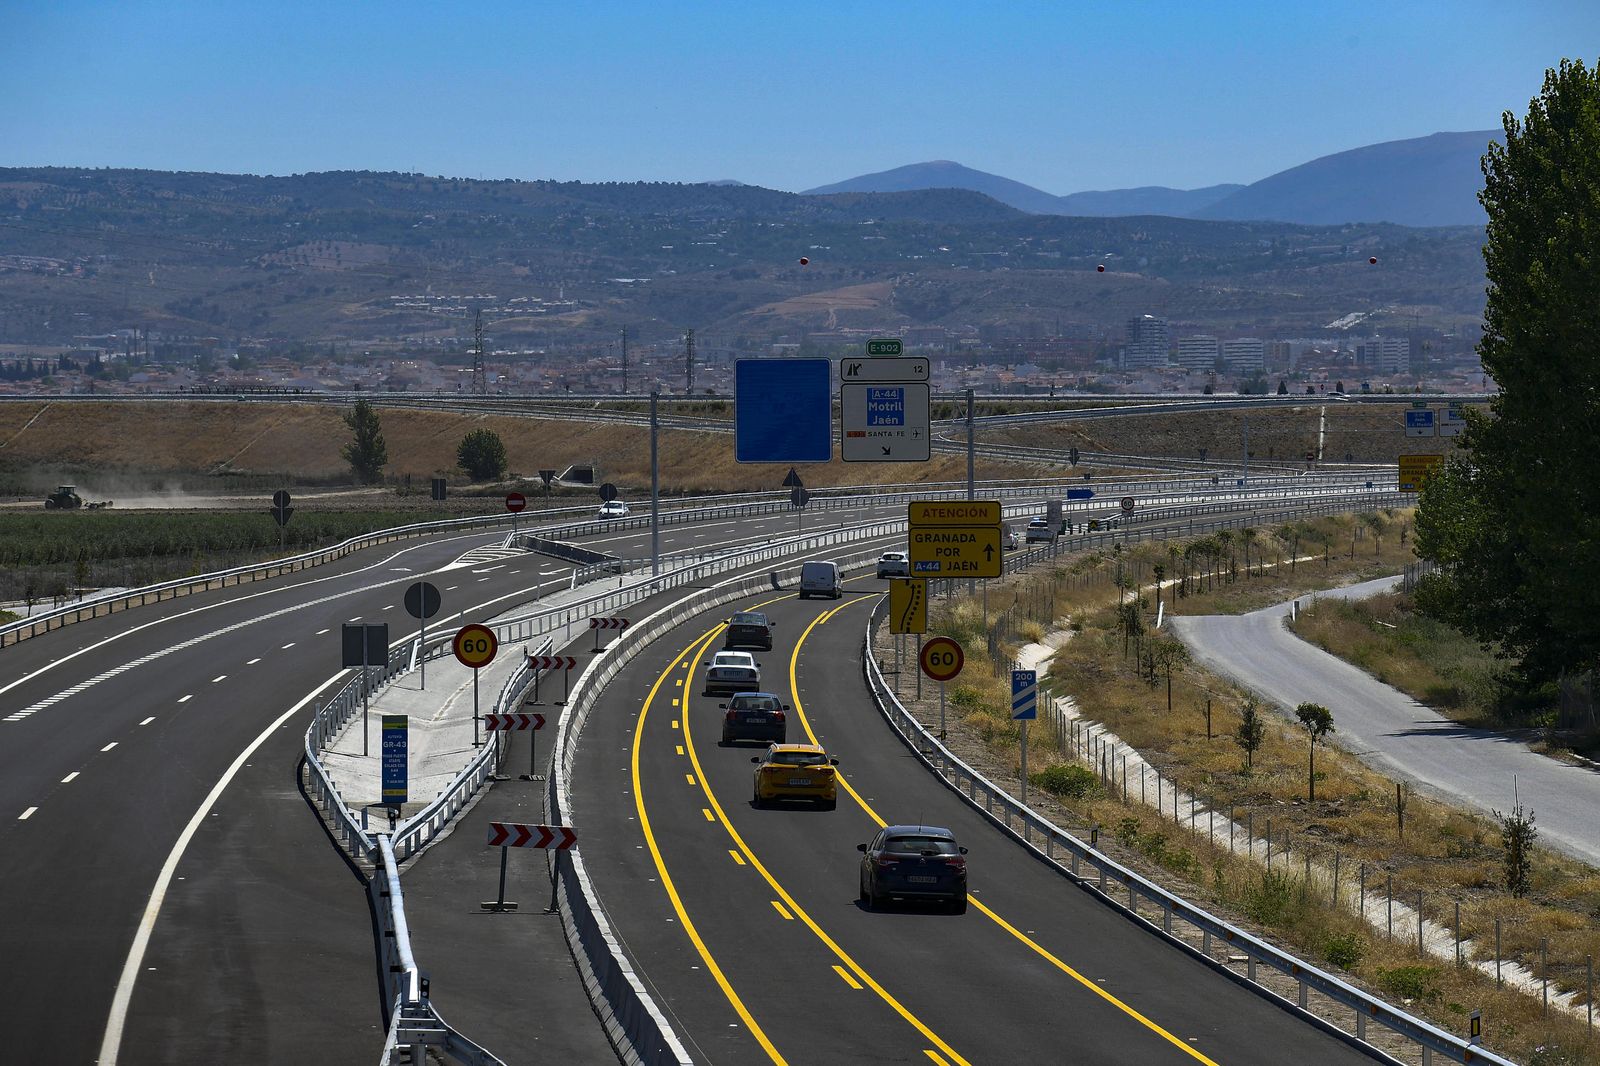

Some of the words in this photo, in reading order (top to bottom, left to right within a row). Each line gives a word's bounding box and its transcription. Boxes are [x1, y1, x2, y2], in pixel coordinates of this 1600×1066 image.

[913, 365, 923, 373] 12
[868, 402, 903, 411] Motril
[872, 415, 899, 425] Jaén
[922, 506, 988, 518] ATENCIÓN
[915, 534, 976, 543] GRANADA
[935, 548, 960, 557] POR
[915, 562, 940, 570] A-44
[946, 560, 978, 571] JAÉN
[464, 639, 487, 653] 60
[930, 652, 954, 666] 60
